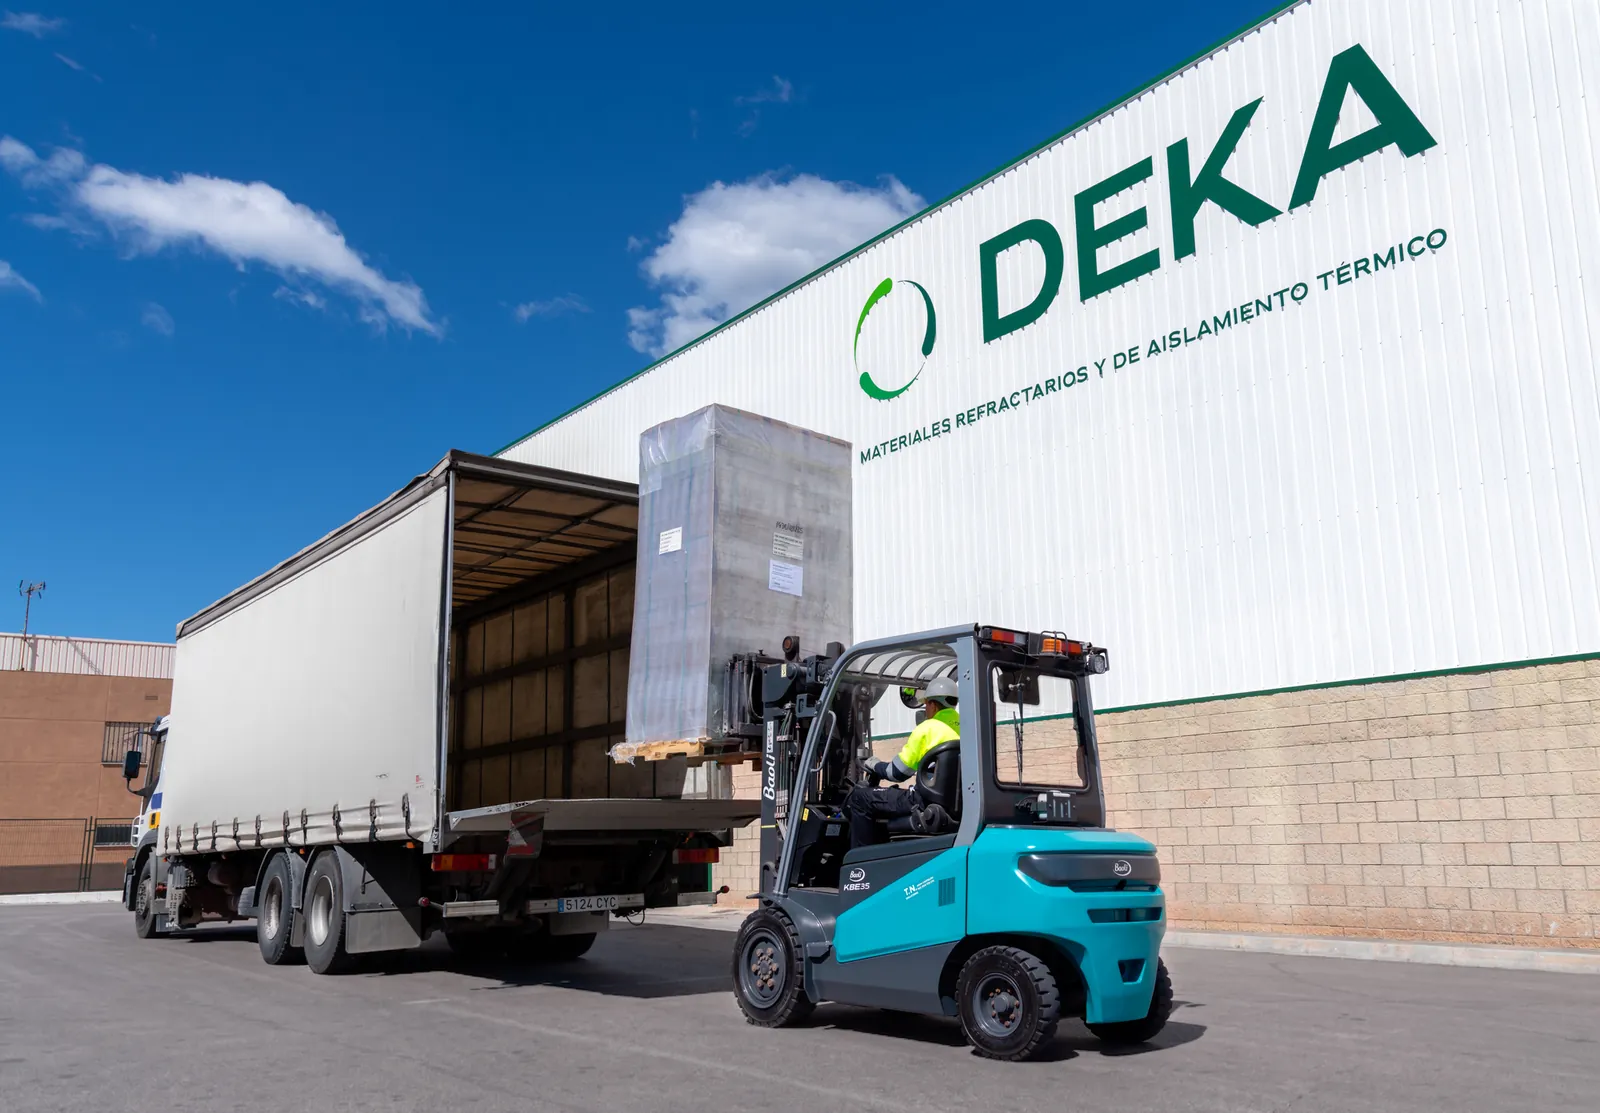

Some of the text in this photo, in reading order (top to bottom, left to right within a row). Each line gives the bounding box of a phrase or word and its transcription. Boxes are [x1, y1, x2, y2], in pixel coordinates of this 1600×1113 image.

[979, 43, 1438, 344] DEKA
[860, 228, 1447, 464] MATERIALES REFRACTARIOS Y DE AISLAMIENTO TÉRMICO
[763, 753, 775, 800] Baoli
[1114, 862, 1128, 872] Baoli
[843, 882, 870, 891] KBE35
[903, 884, 917, 896] T.N.
[566, 896, 616, 910] 5124 CYC
